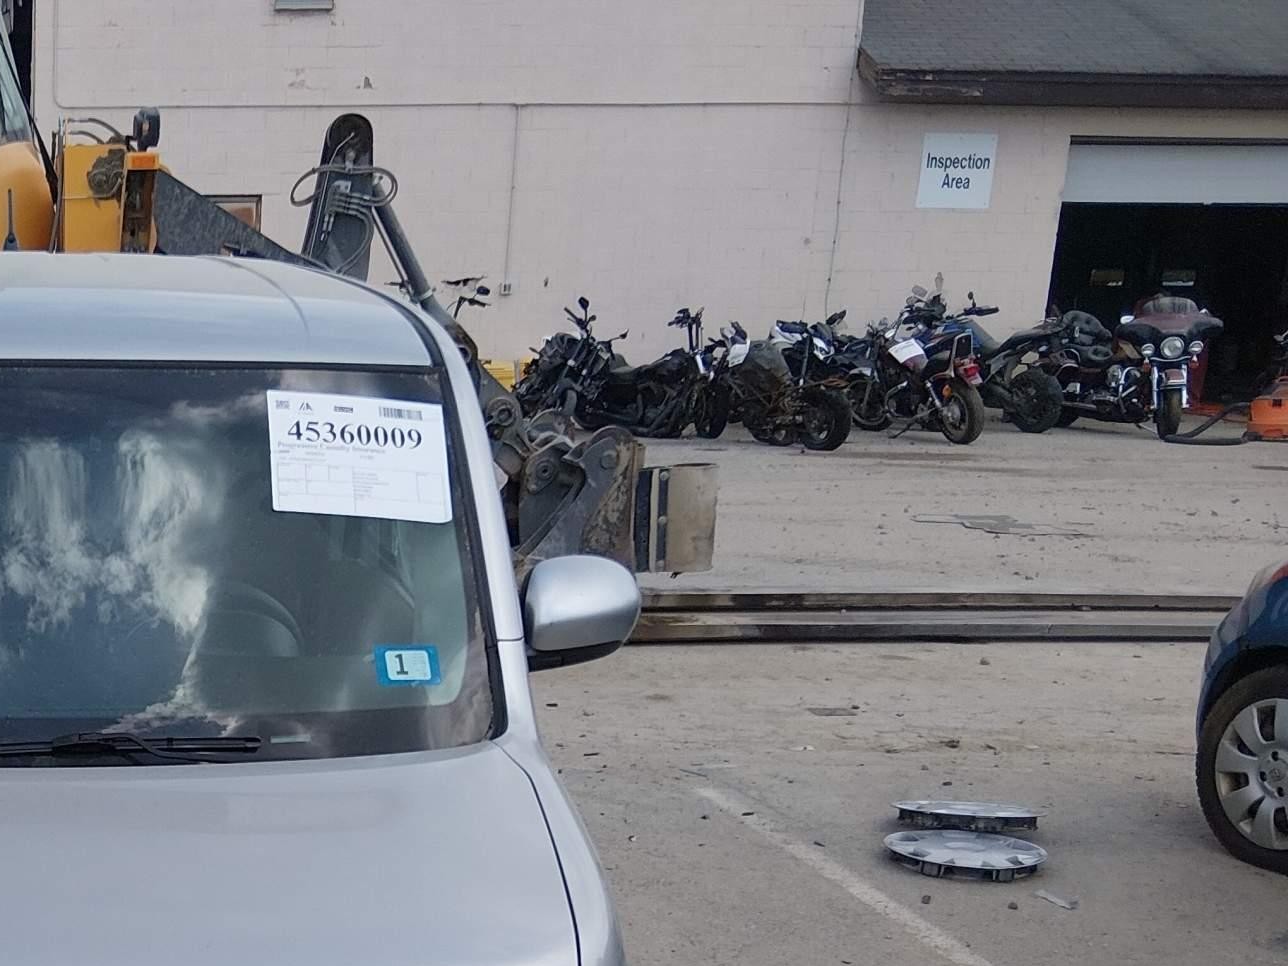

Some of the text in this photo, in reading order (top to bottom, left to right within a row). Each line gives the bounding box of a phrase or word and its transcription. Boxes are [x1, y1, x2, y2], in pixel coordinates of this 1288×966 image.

[926, 152, 991, 172] Inspection
[941, 173, 971, 189] Area
[287, 420, 422, 449] 45360009
[394, 654, 409, 675] 1
